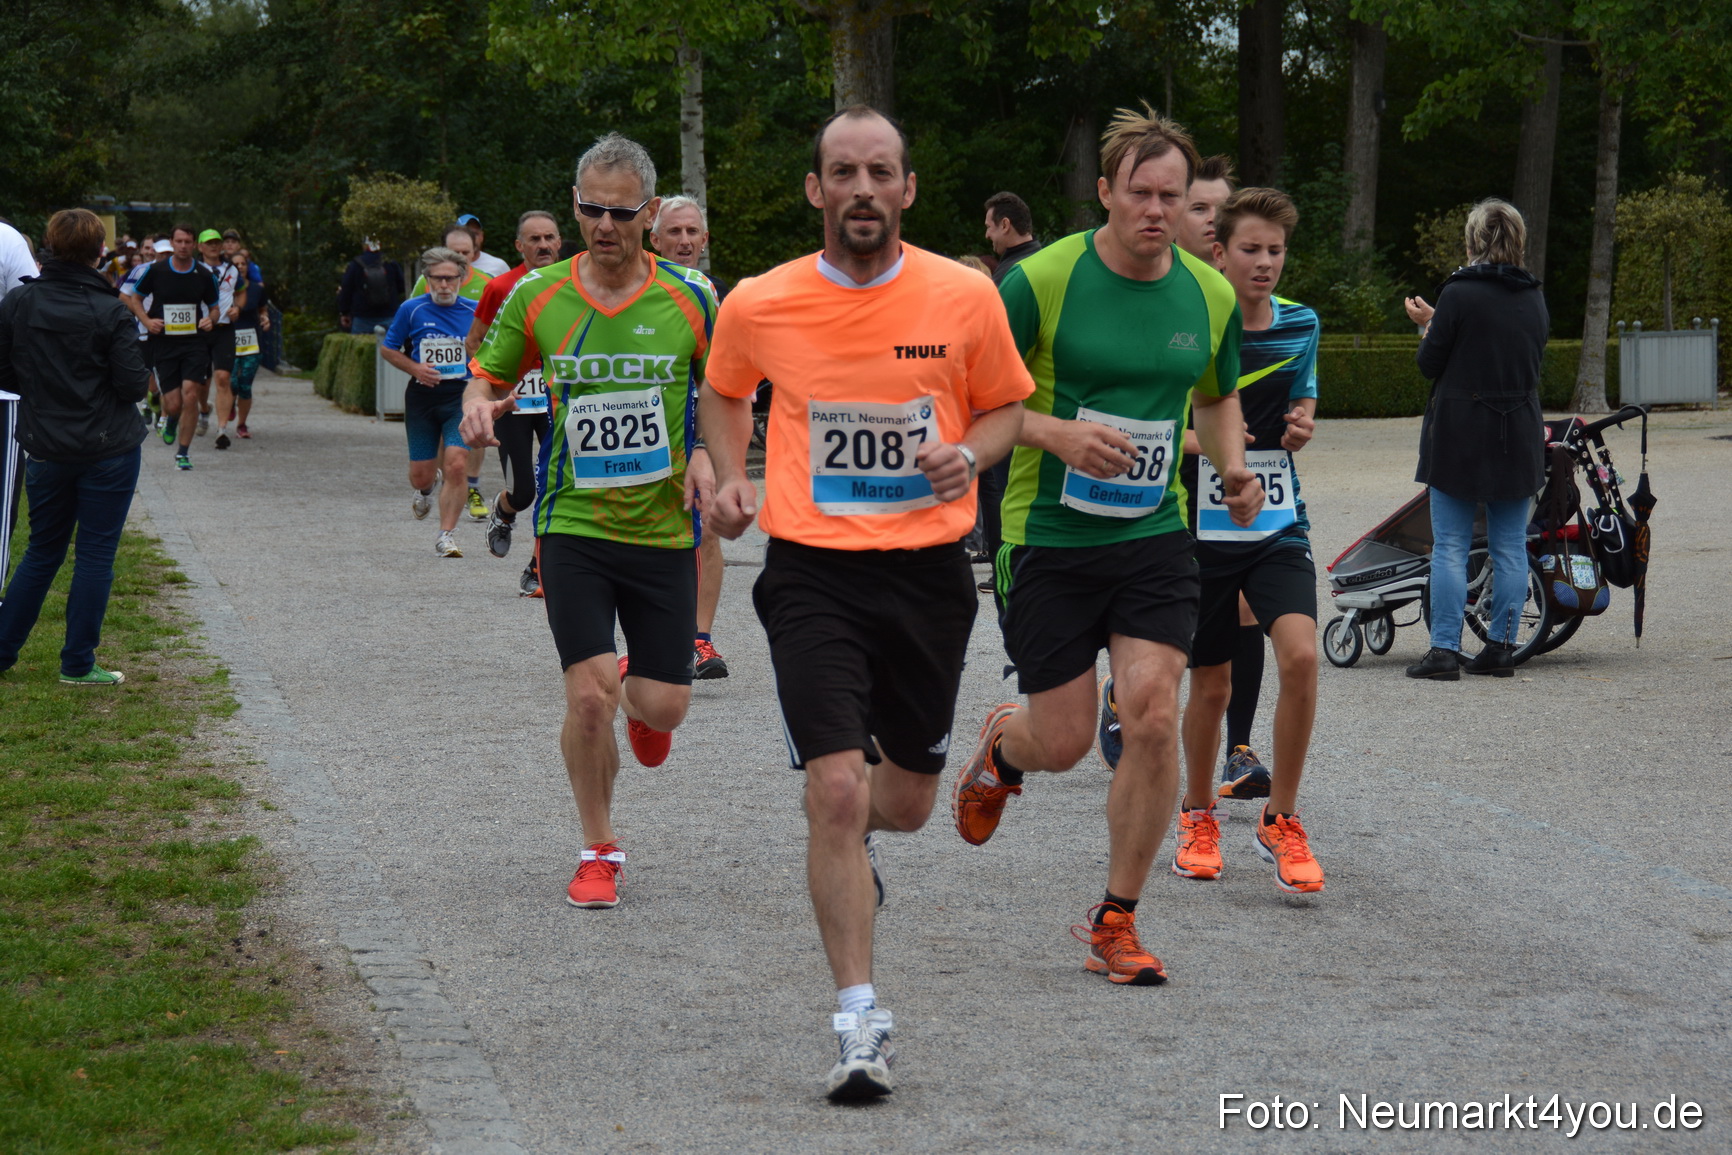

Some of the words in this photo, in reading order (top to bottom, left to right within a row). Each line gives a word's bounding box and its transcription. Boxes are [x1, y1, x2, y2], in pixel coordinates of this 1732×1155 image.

[171, 311, 191, 323] 298
[1169, 332, 1199, 347] AOK
[425, 347, 462, 363] 2608
[894, 345, 947, 359] THULE
[549, 353, 678, 384] BOCK
[517, 377, 546, 395] 216
[532, 399, 545, 407] Karl
[571, 404, 600, 415] ARTL
[602, 400, 649, 412] Neumarkt
[812, 411, 855, 423] PARTL
[858, 413, 917, 425] Neumarkt
[577, 412, 660, 452] 2825
[824, 426, 928, 470] 2087
[604, 458, 642, 474] Frank
[1244, 459, 1277, 469] eumarkt
[852, 481, 904, 498] Marco
[1088, 484, 1143, 504] Gerhard
[1209, 472, 1284, 506] 35
